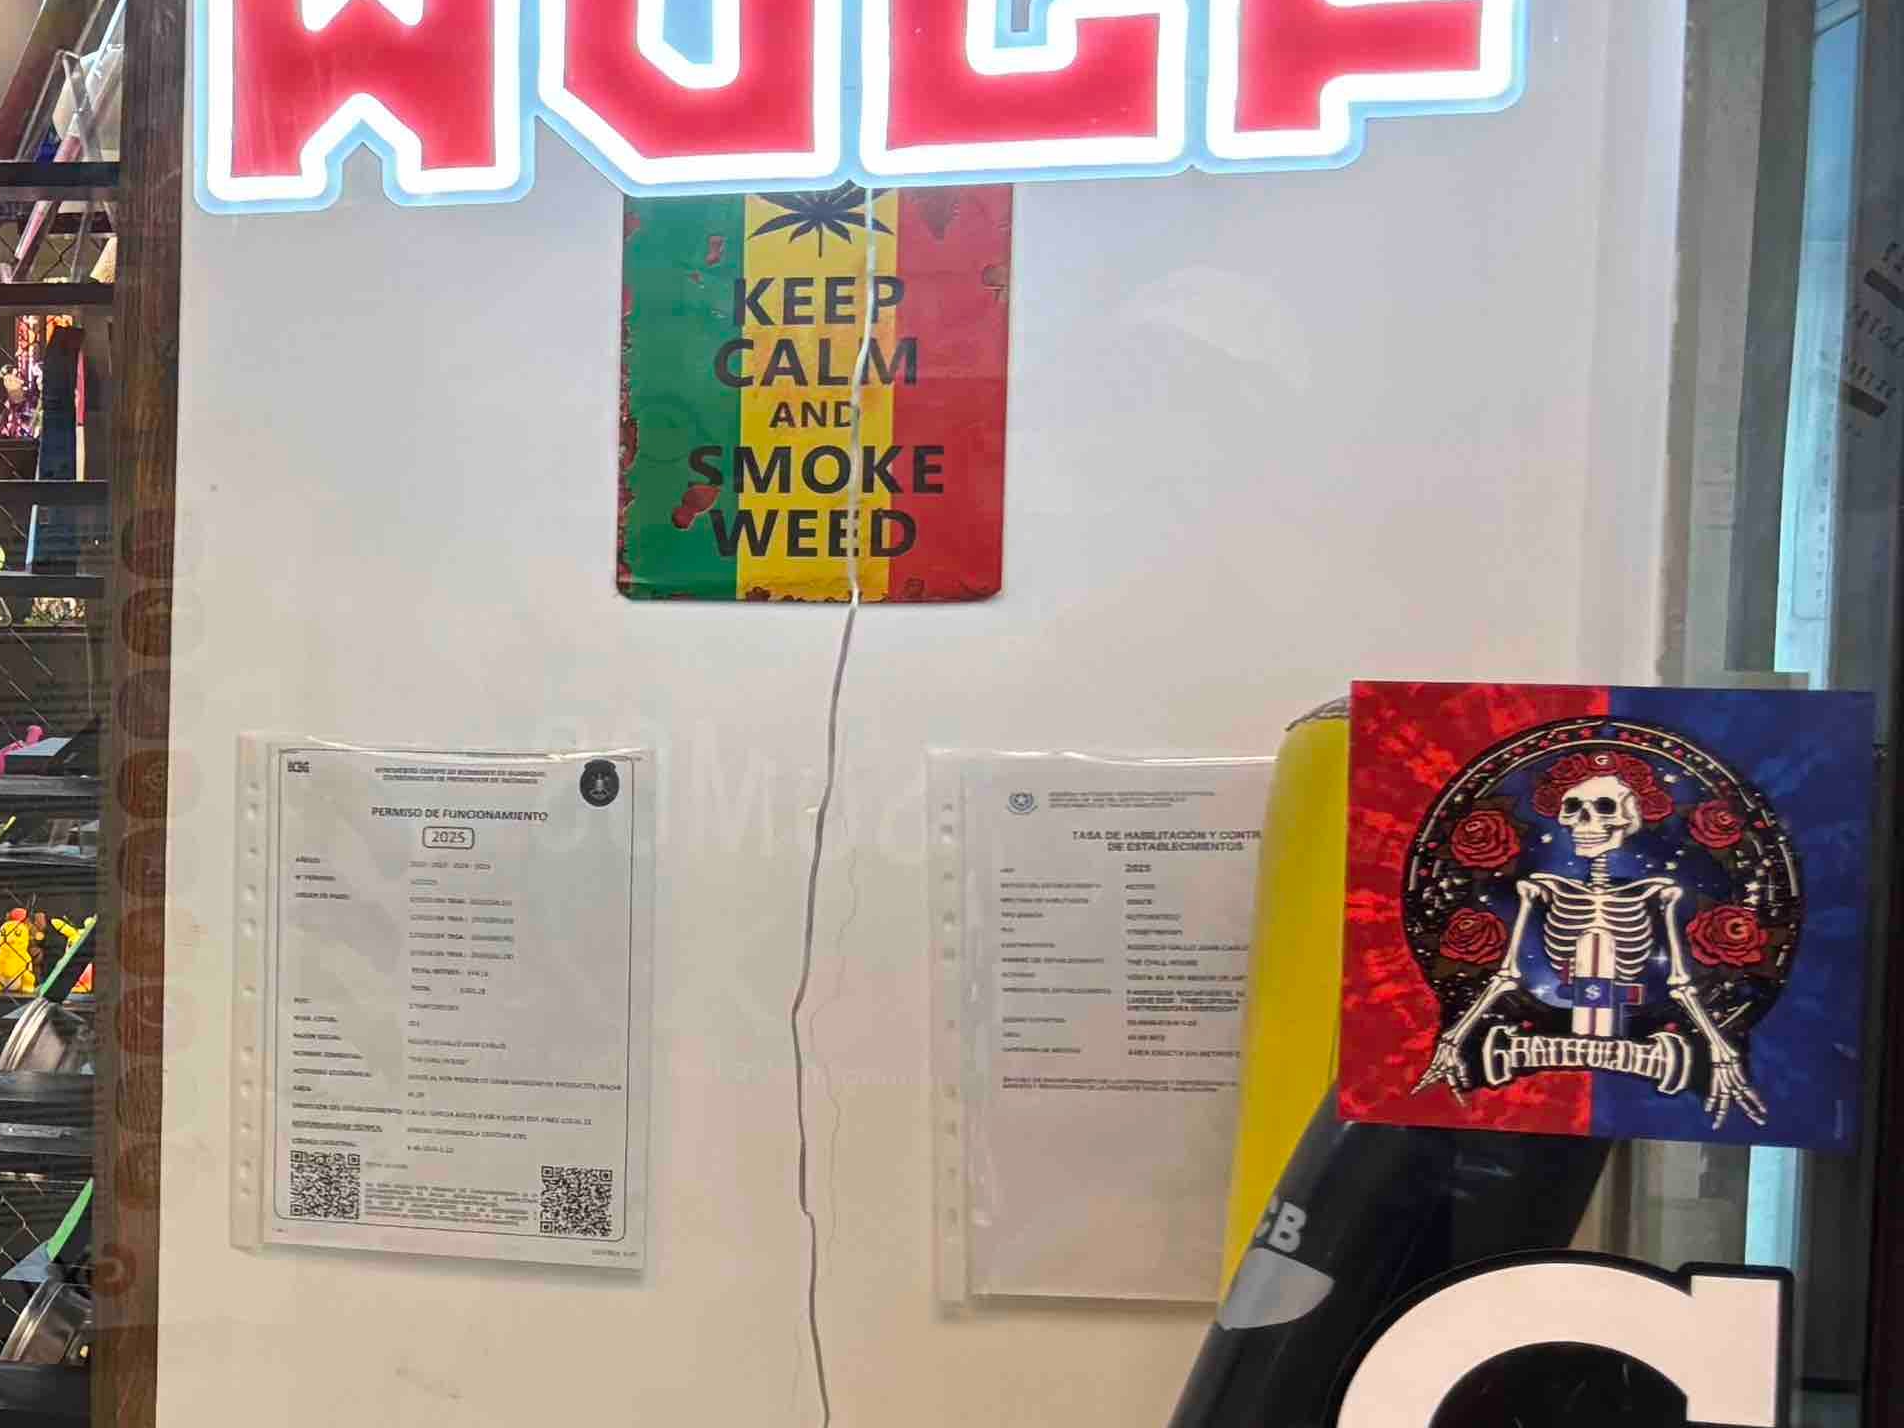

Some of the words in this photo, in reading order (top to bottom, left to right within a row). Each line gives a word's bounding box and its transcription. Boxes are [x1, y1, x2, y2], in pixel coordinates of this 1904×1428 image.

[734, 275, 905, 326] KEEP
[714, 337, 918, 388] CALM
[769, 401, 861, 429] AND
[690, 444, 944, 495] SMOKE
[709, 508, 917, 558] WEED
[371, 807, 422, 819] PERMISO
[425, 808, 440, 819] DE
[431, 830, 466, 845] 2025
[1072, 830, 1102, 841] TASA
[1105, 830, 1122, 841] DE
